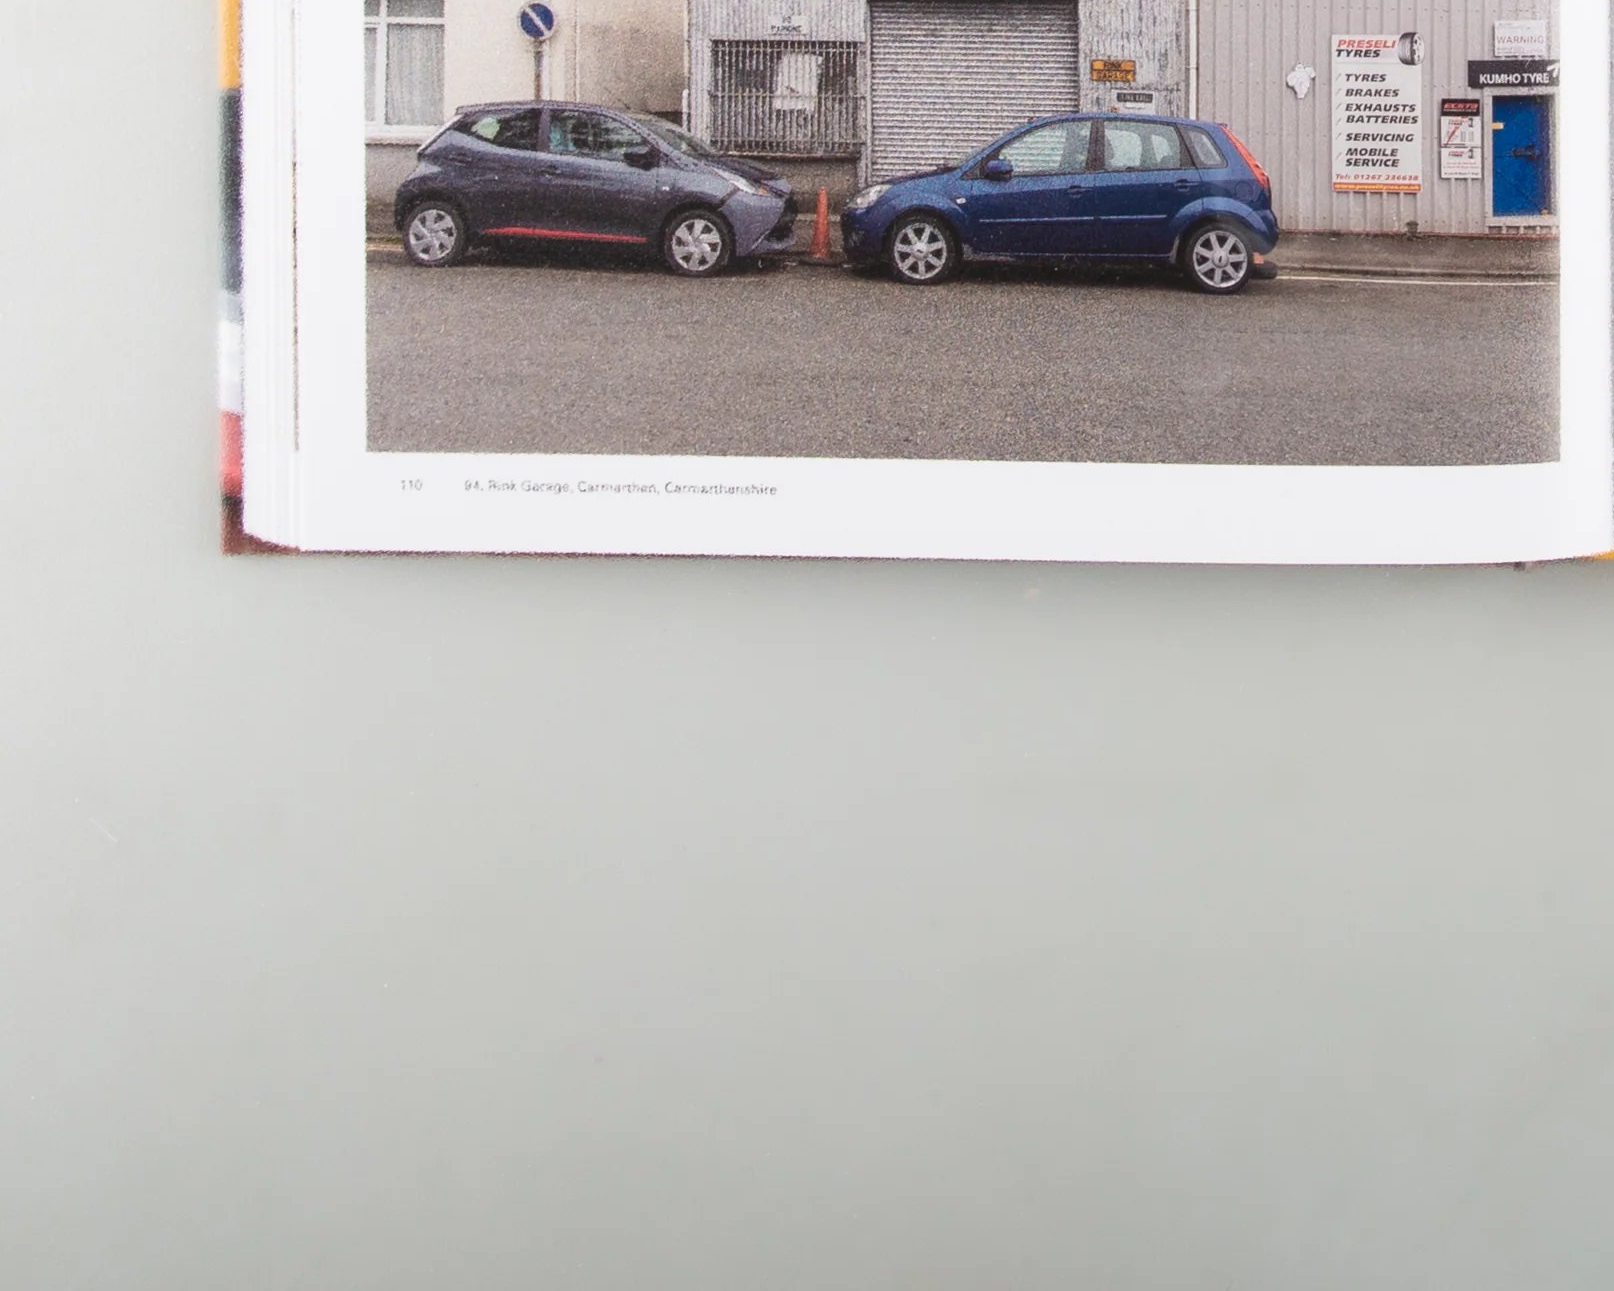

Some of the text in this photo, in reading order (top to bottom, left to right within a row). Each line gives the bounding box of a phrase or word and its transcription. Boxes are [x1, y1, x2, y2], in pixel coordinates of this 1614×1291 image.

[1336, 39, 1396, 49] PRESELI
[1496, 35, 1545, 44] WARNING
[1335, 49, 1381, 58] TYRES
[1345, 74, 1387, 82] TYRES
[1479, 73, 1550, 84] KUMHO TYRE
[1345, 89, 1400, 97] BRAKES
[1345, 103, 1416, 113] EXHAUSTS
[1346, 115, 1418, 124] BATTERIES
[1345, 133, 1414, 142] SERVICING
[1345, 148, 1398, 157] MOBILE
[1345, 158, 1400, 168] SERVICE
[664, 481, 778, 495] Carmarthenshire
